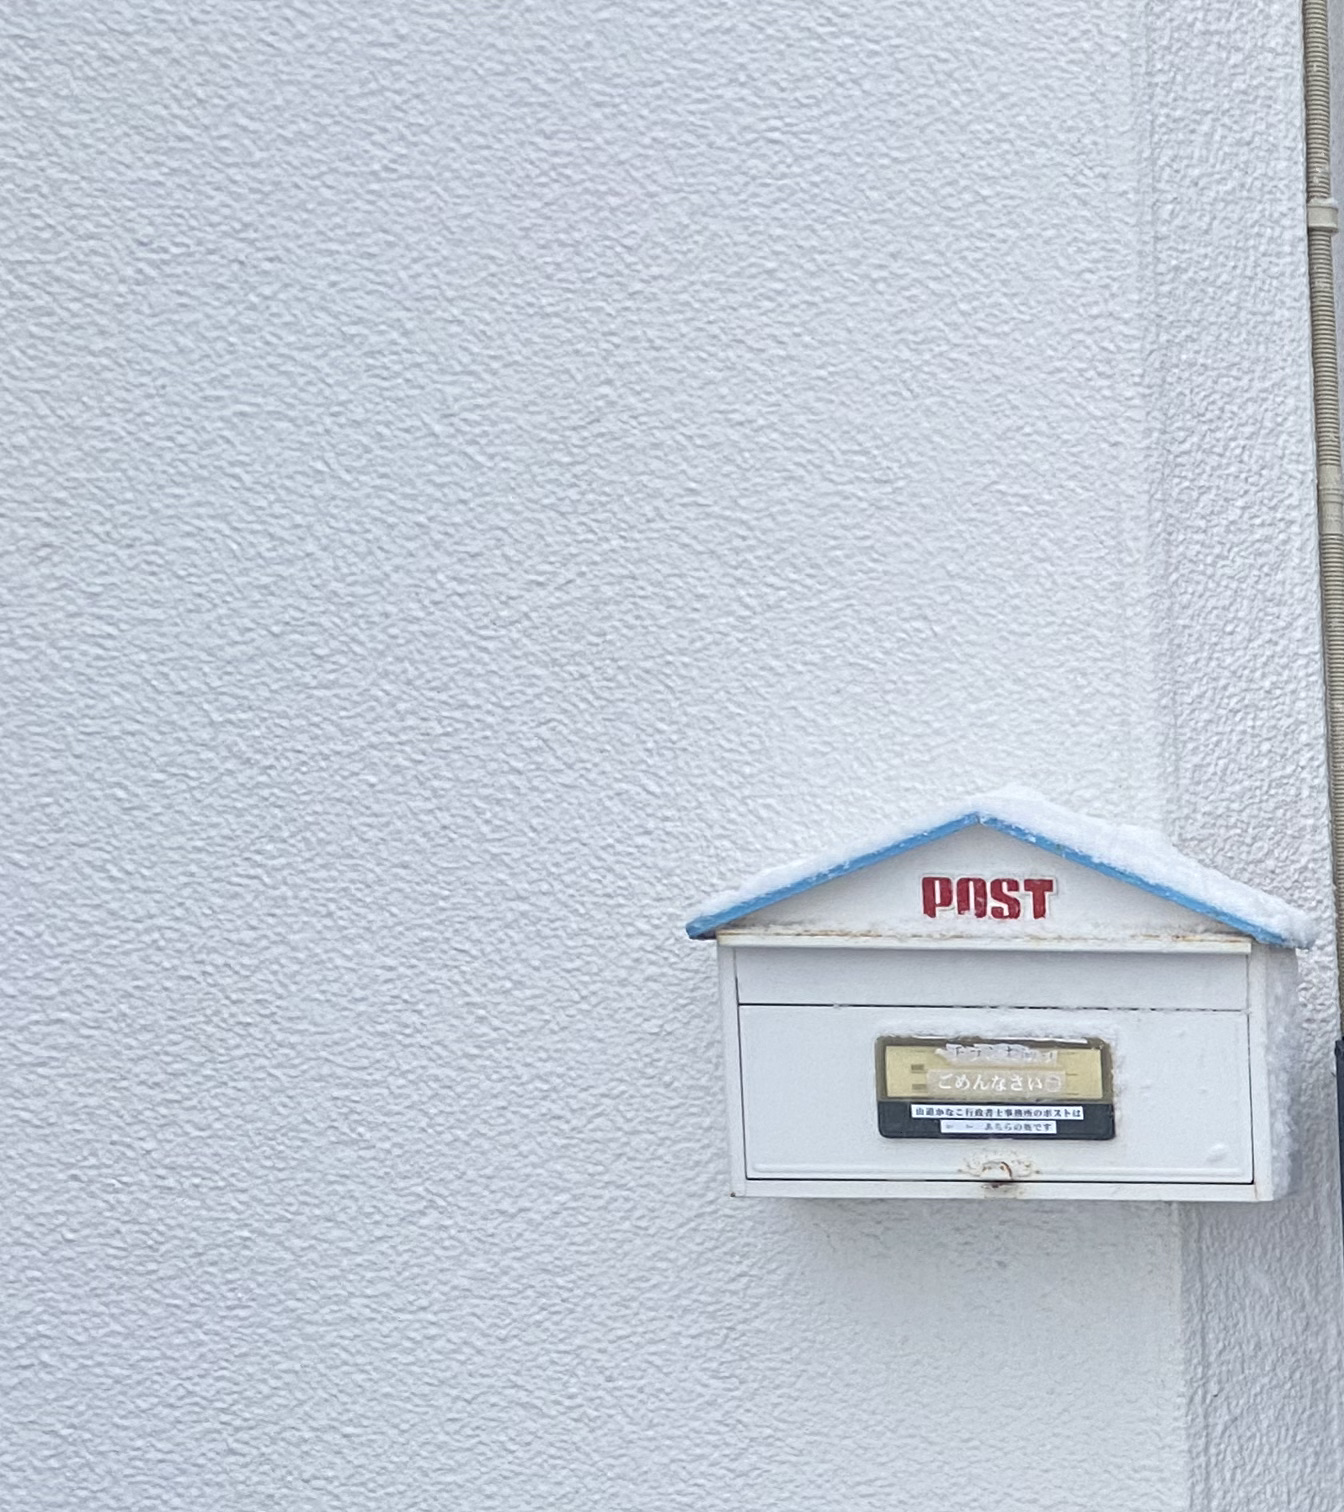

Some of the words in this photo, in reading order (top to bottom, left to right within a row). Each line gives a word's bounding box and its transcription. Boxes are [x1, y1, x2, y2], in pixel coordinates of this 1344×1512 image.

[921, 875, 1055, 920] POST
[938, 1074, 1043, 1092] ごめんなさい
